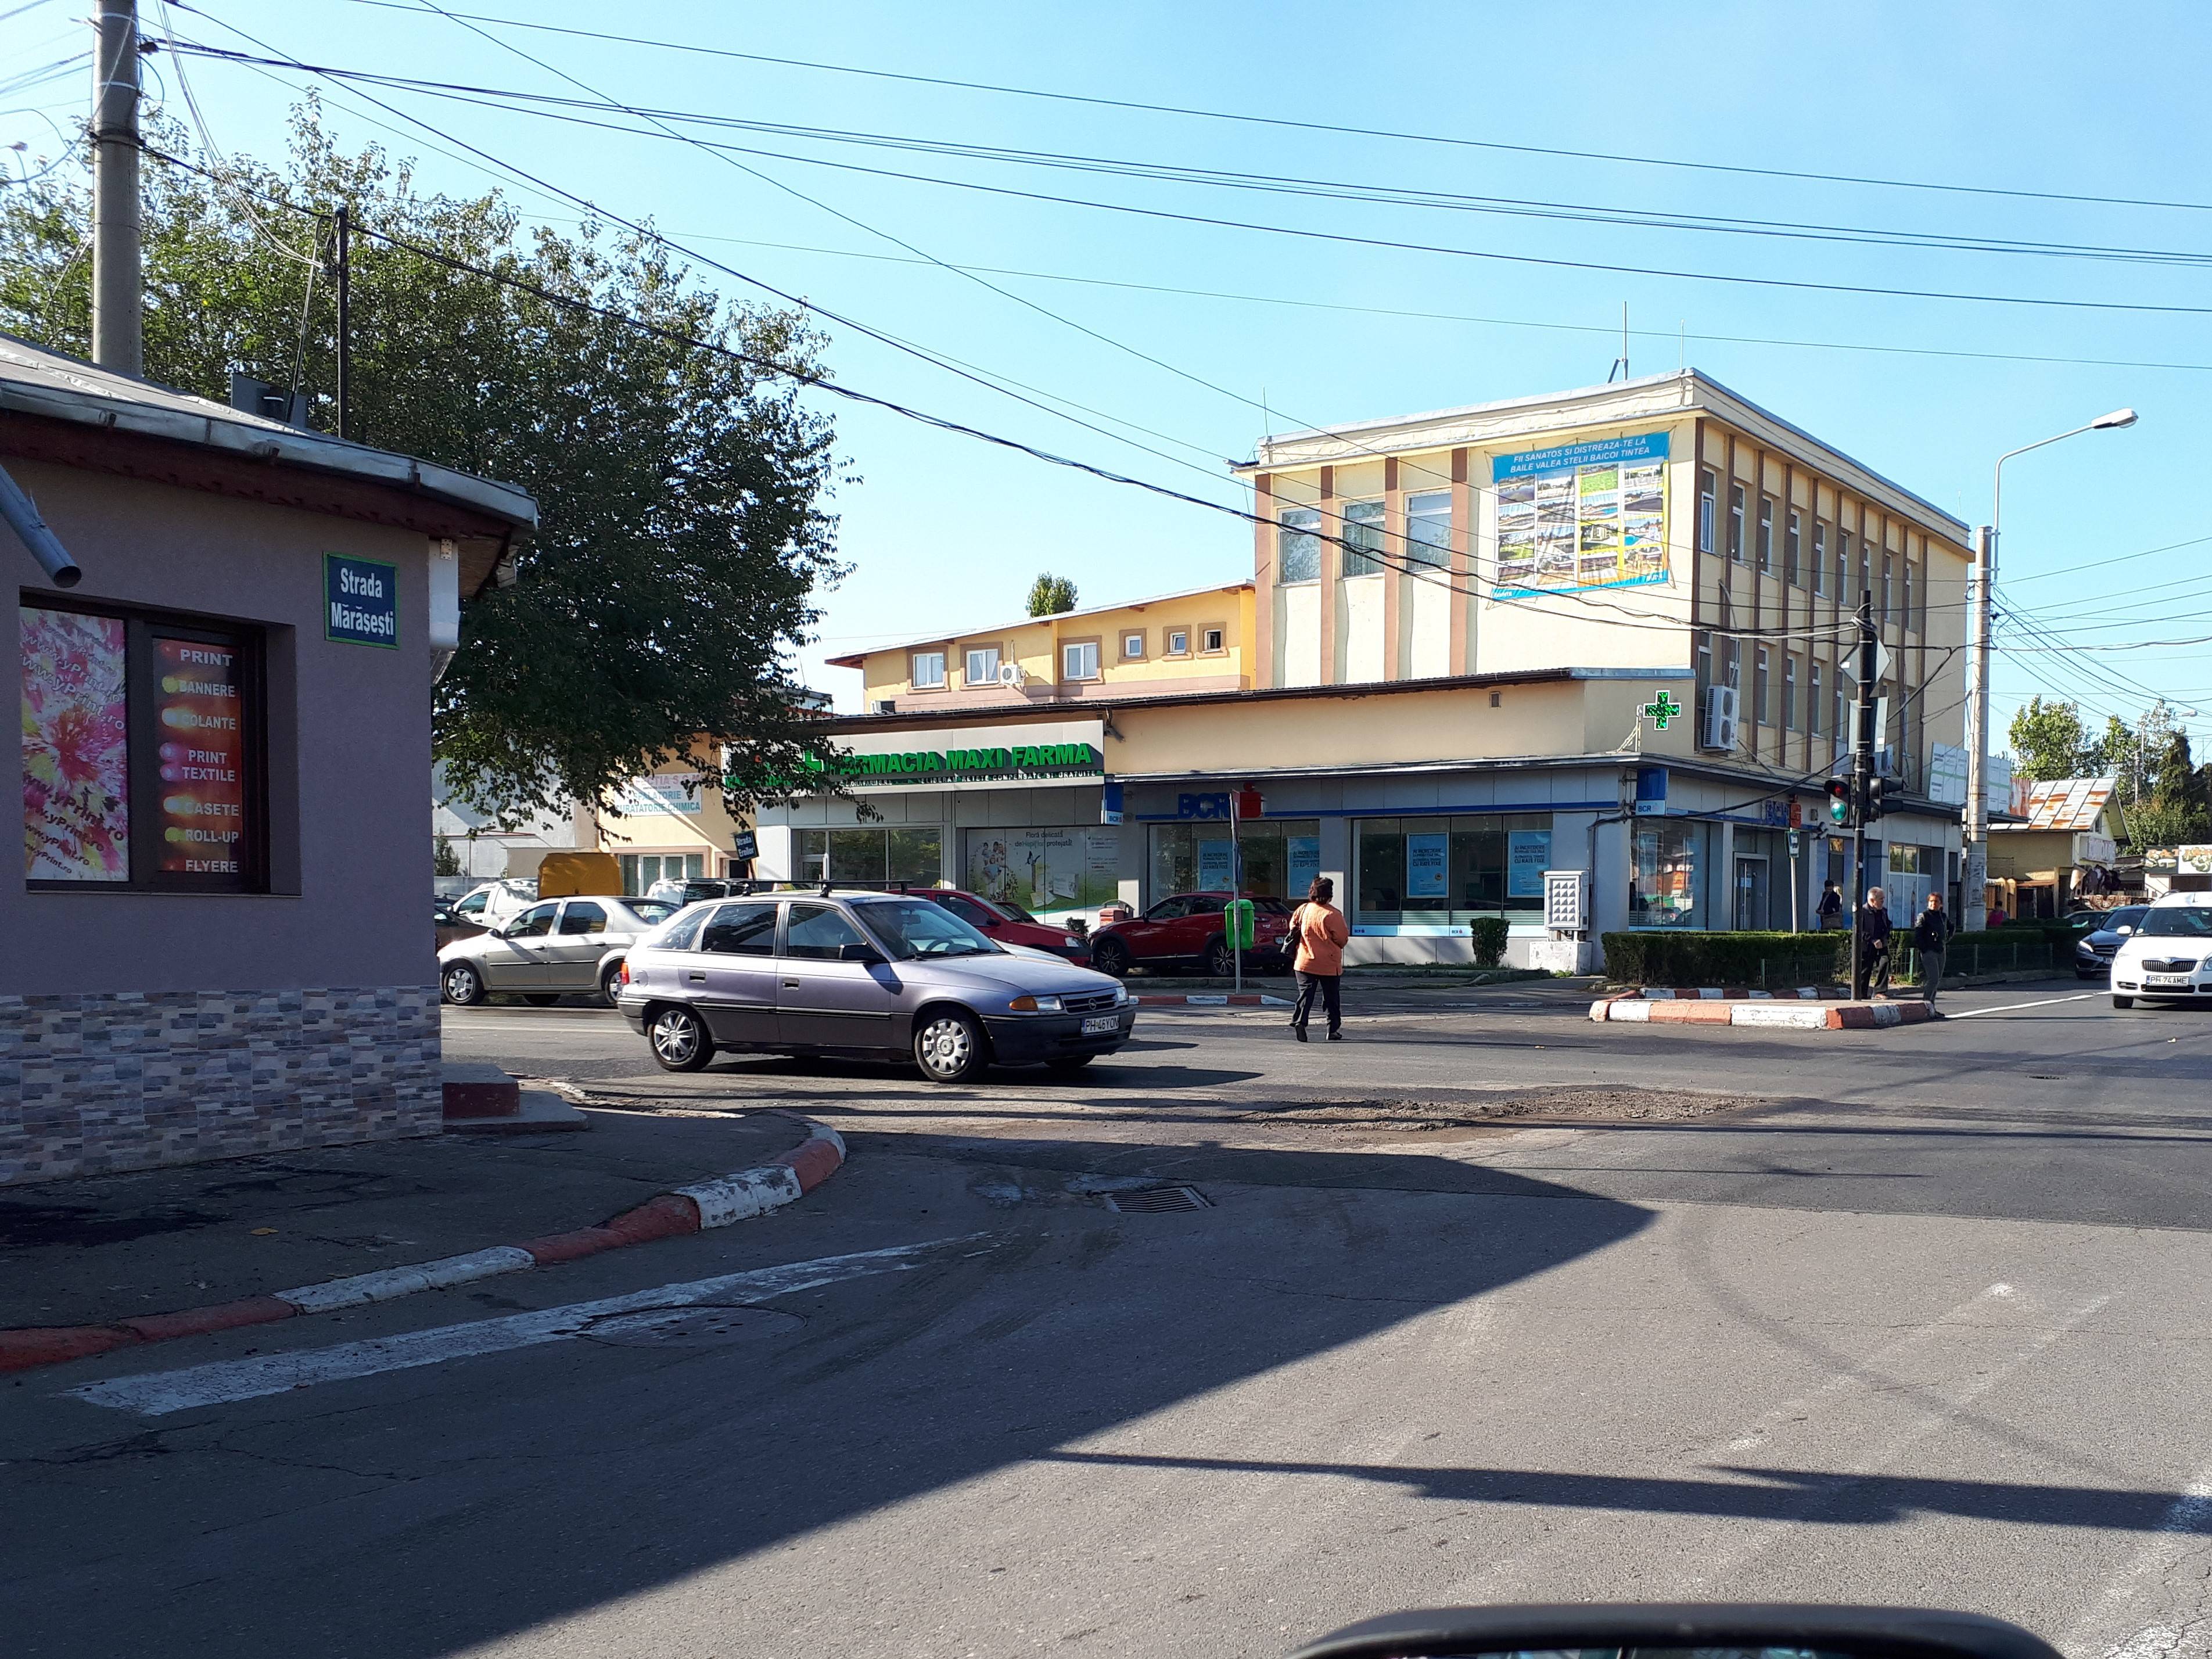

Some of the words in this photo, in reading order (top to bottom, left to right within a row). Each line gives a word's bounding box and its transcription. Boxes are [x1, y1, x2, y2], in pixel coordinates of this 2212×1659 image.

[1514, 455, 1523, 464] FII
[1525, 450, 1563, 463] SANATOS
[1565, 448, 1572, 457] SI
[1574, 440, 1633, 455] DISTREAZA-TE
[1635, 437, 1646, 447] LA
[1510, 461, 1534, 474] BAILE
[1536, 458, 1561, 470] VALEA
[1563, 455, 1588, 465] STELII
[1589, 451, 1619, 461] BAICOI
[1621, 447, 1650, 457] TINTEA
[340, 567, 383, 598] Strada
[179, 649, 233, 667] PRINT
[179, 679, 235, 697] BANNERE
[182, 714, 236, 730] COLANTE
[188, 749, 227, 764] PRINT
[946, 748, 1005, 770] MAXI
[1011, 743, 1094, 768] FARMA
[181, 766, 235, 782] TEXTILE
[992, 772, 1042, 781] COMPENSATE
[1058, 770, 1096, 778] GRATUITE
[185, 802, 240, 817] CASETE
[667, 802, 701, 812] CHIMICA
[185, 829, 239, 843] ROLL-UP
[736, 835, 752, 846] Strada
[185, 859, 239, 873] FLYERE
